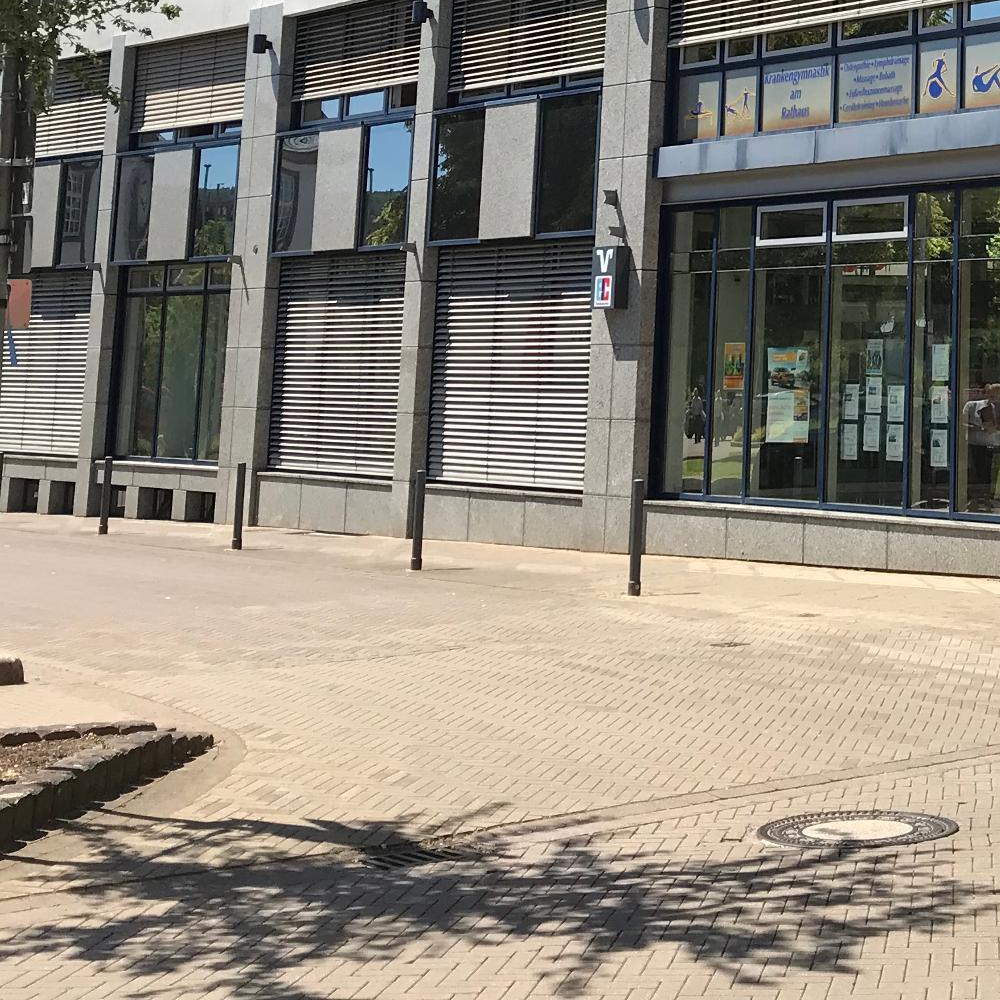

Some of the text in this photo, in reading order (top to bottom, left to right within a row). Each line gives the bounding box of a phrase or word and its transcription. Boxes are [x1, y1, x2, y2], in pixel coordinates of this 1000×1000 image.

[764, 63, 829, 85] Krankengymnastik
[789, 89, 802, 100] am
[781, 104, 810, 120] Rathaus
